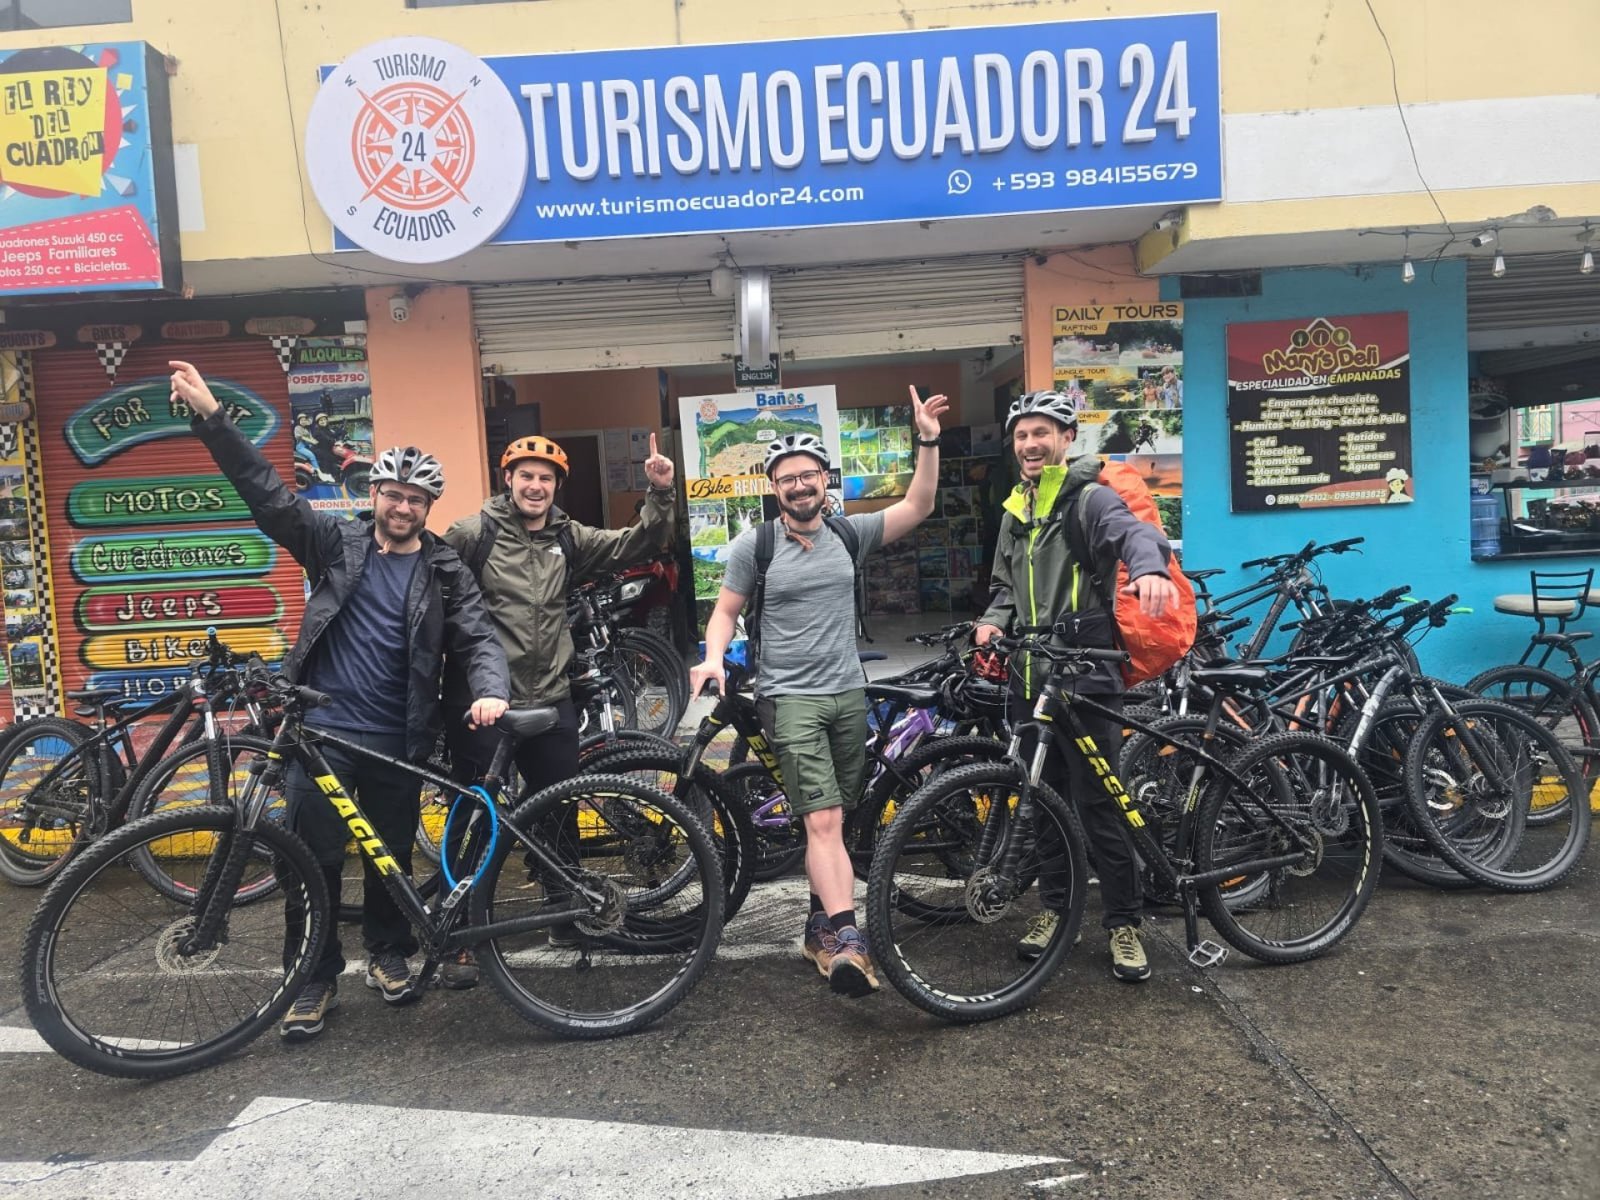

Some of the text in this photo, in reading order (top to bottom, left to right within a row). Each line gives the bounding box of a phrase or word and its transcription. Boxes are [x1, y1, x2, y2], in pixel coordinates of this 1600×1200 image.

[344, 74, 357, 88] W
[373, 53, 447, 82] TURISMO
[469, 75, 482, 88] N
[5, 76, 93, 115] EL REY
[30, 108, 70, 139] DEL
[520, 41, 1196, 181] TURISMO ECUADOR 24
[401, 131, 427, 162] 24
[992, 162, 1198, 191] +593 984155679
[536, 186, 864, 219] www.turismoecuador24.com
[372, 206, 456, 242] ECUADOR
[0, 232, 124, 249] uadrones Suzuki 450 cc
[2, 246, 117, 264] Jeeps Familiares
[0, 261, 131, 277] otos 250 cc Bicicletas.
[1056, 304, 1178, 322] DAILY TOURS
[92, 326, 126, 341] BIKES
[1061, 324, 1098, 332] RAFTING
[300, 346, 365, 363] ALQUILER
[1263, 344, 1379, 375] Mary's Deli
[741, 371, 773, 381] ENGLISH
[1235, 369, 1401, 391] ESPECIALIDAD EN EMPANADAS
[756, 391, 806, 407] Baños
[1268, 396, 1325, 409] Empanadas
[91, 397, 151, 441] FOR
[104, 487, 225, 514] MOTOS
[690, 477, 773, 498] Bike RENTA
[92, 538, 246, 572] Cuadrones
[117, 593, 222, 621] Jeeps
[1074, 735, 1146, 828] EAGLE
[314, 774, 402, 876] EAGLE
